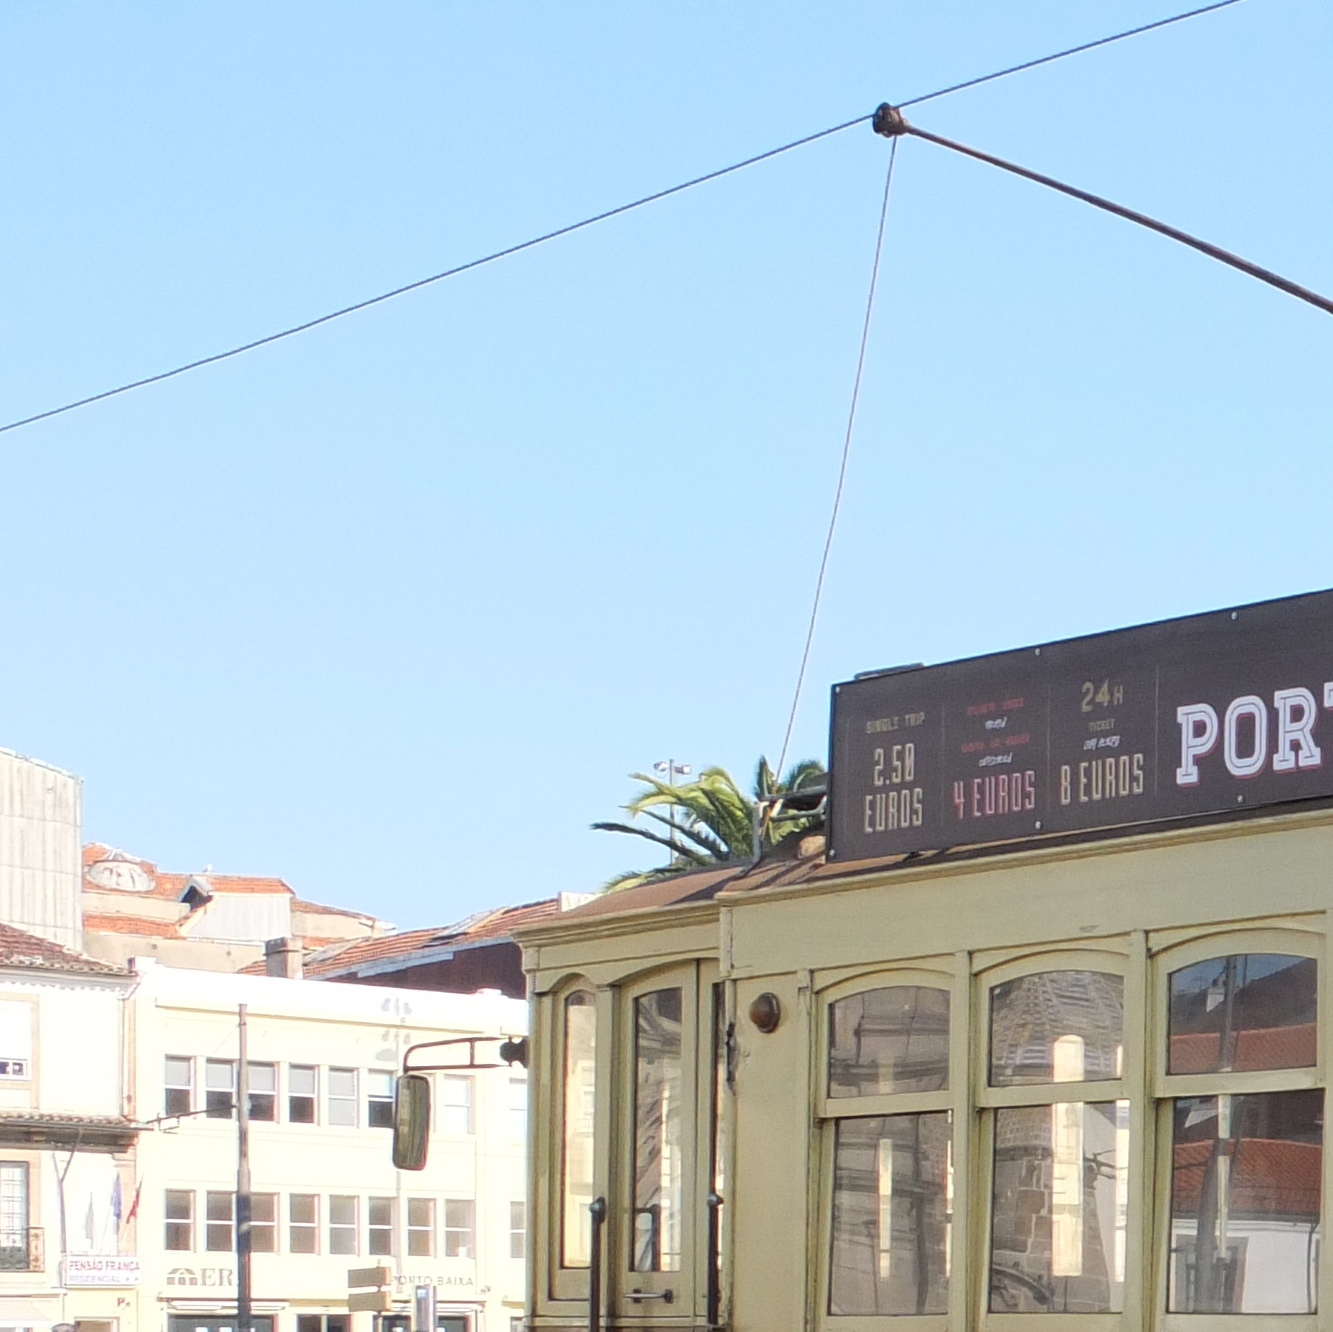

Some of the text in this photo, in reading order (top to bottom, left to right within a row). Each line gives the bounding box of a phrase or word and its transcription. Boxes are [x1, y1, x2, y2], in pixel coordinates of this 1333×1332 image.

[873, 743, 915, 788] 2.50
[1060, 753, 1144, 806] 8 EUROS
[864, 787, 923, 833] EUROS
[953, 770, 1036, 820] 4 EUROS
[105, 1260, 140, 1273] FRANÇA
[200, 1267, 233, 1287] ER
[437, 1276, 474, 1287] BAIXA
